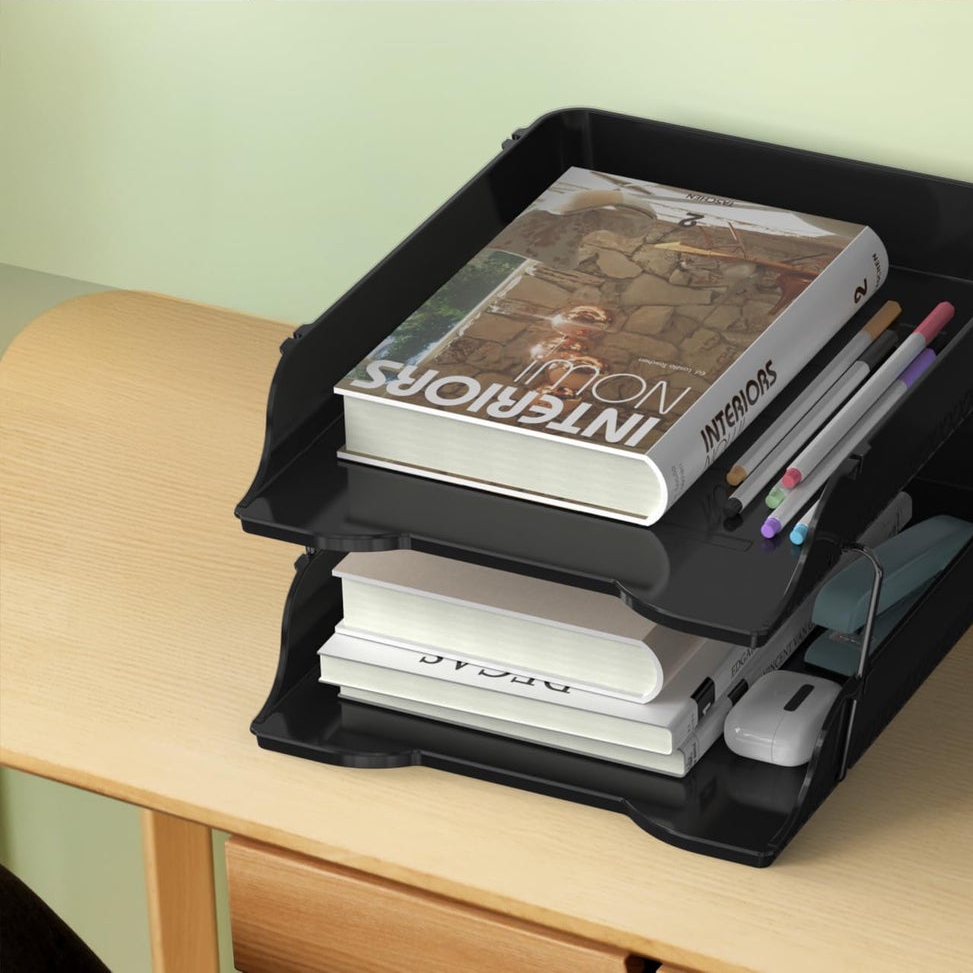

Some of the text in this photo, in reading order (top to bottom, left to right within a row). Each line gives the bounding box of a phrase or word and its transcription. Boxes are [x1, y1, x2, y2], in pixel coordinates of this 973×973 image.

[686, 193, 735, 207] TASCHEN
[679, 212, 704, 228] 2
[853, 278, 868, 305] 2
[350, 360, 661, 448] INTERIORS
[700, 359, 777, 453] INTERIORS
[731, 647, 755, 677] EDGA
